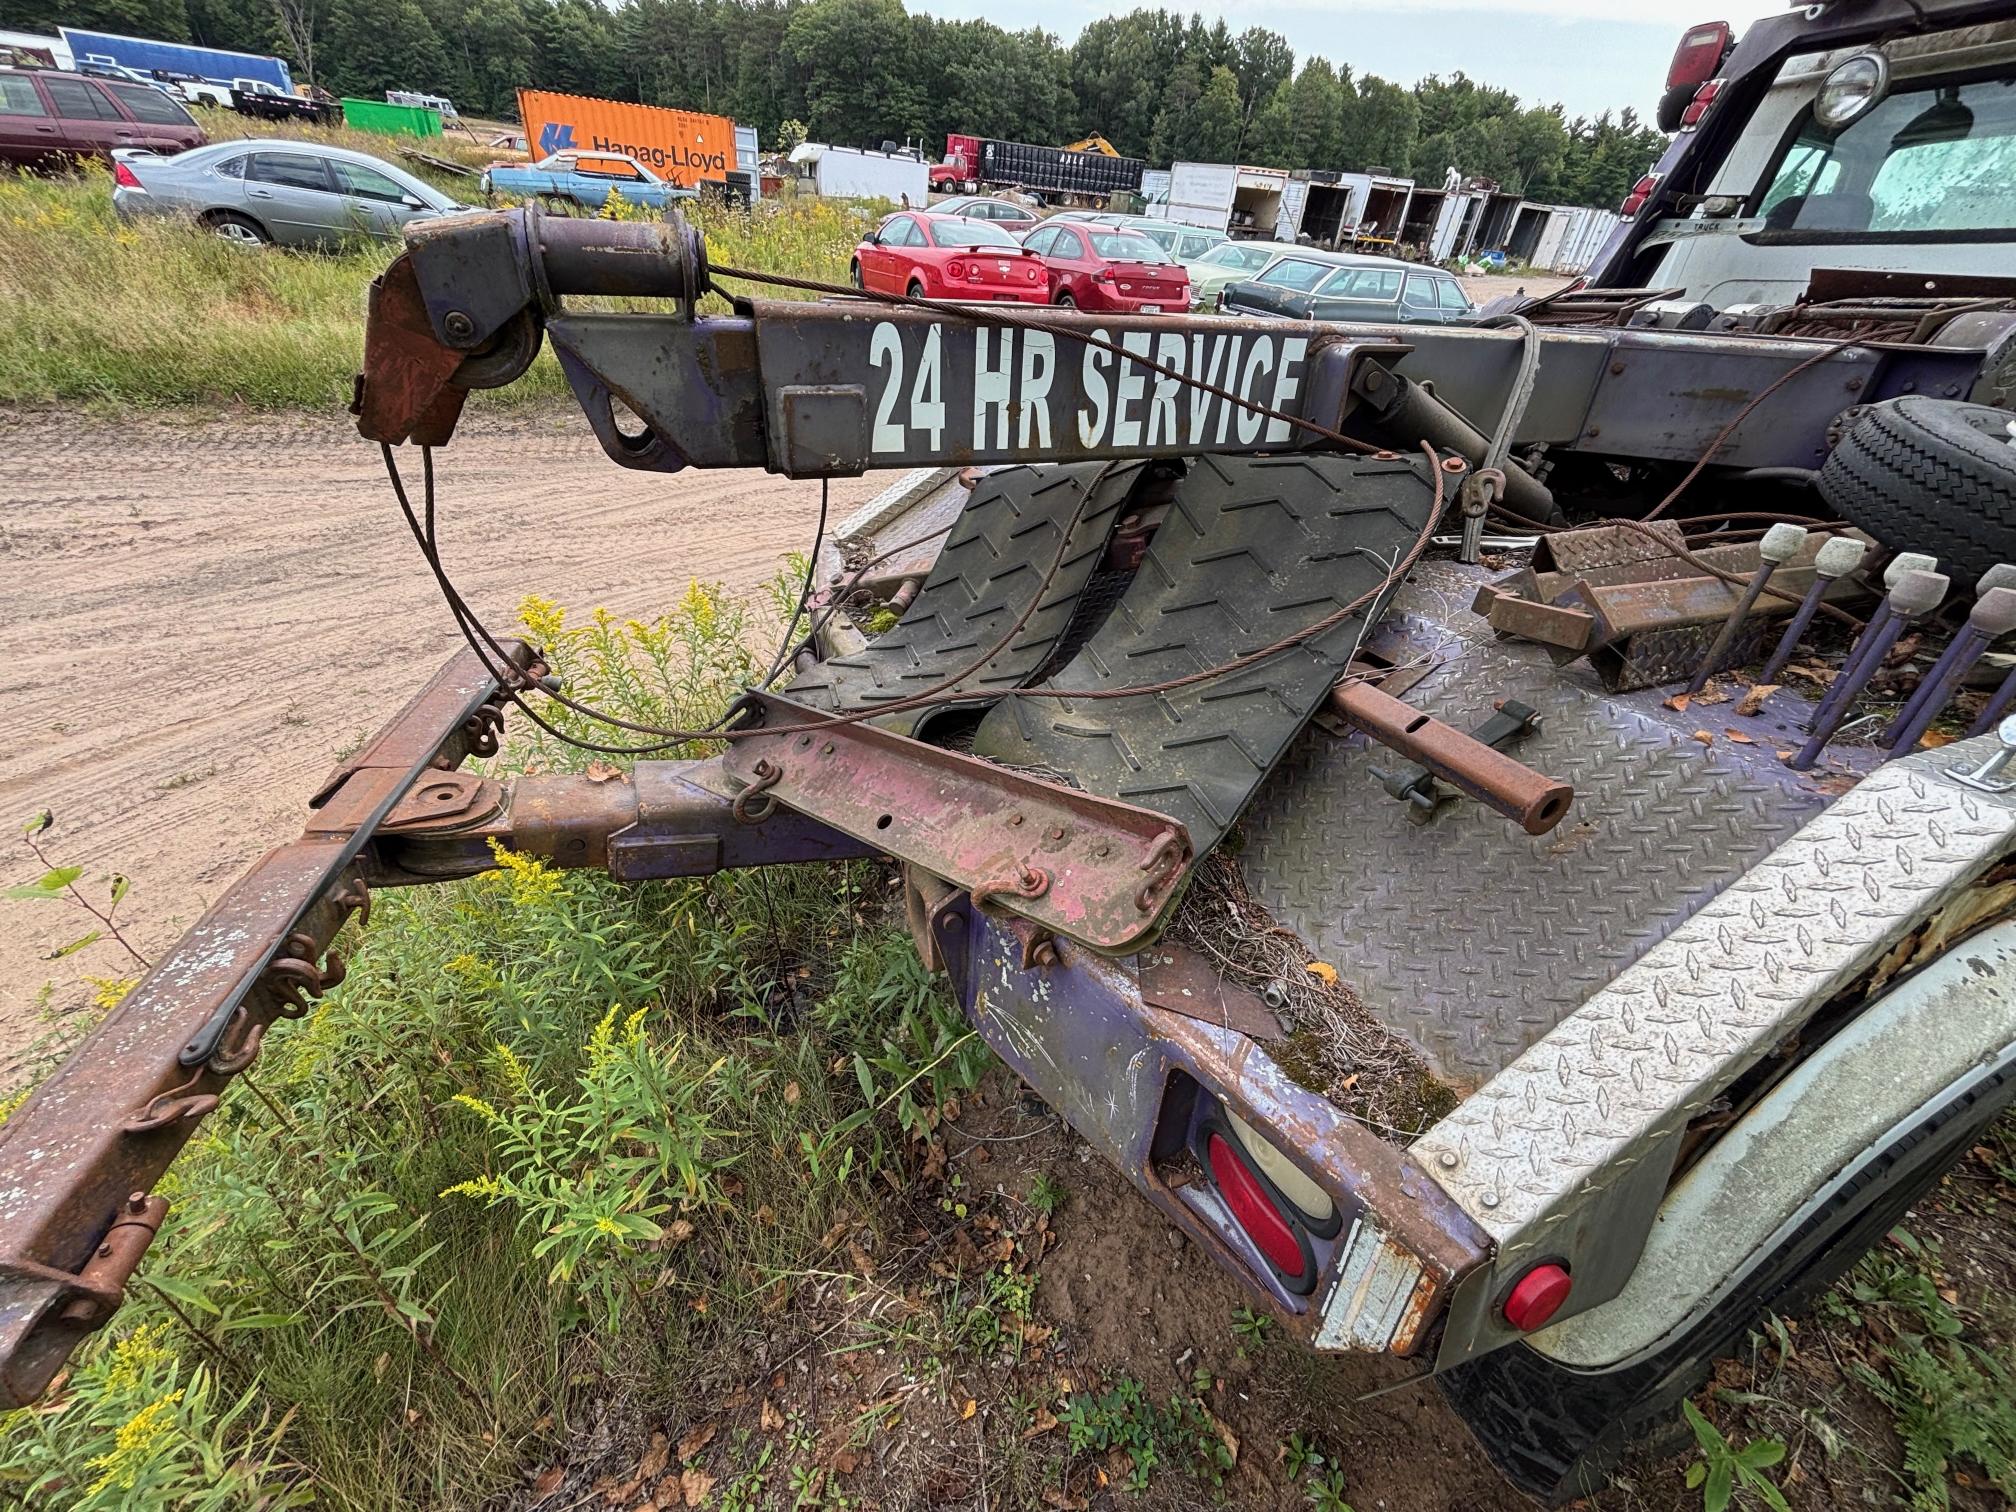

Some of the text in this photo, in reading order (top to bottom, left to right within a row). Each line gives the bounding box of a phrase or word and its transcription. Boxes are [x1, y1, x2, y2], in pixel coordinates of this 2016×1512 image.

[593, 136, 726, 172] Hapag-Lloyd
[1060, 153, 1085, 165] AXLE
[1694, 223, 1720, 231] TRUCK
[869, 321, 1308, 453] 24 HR SERVICE
